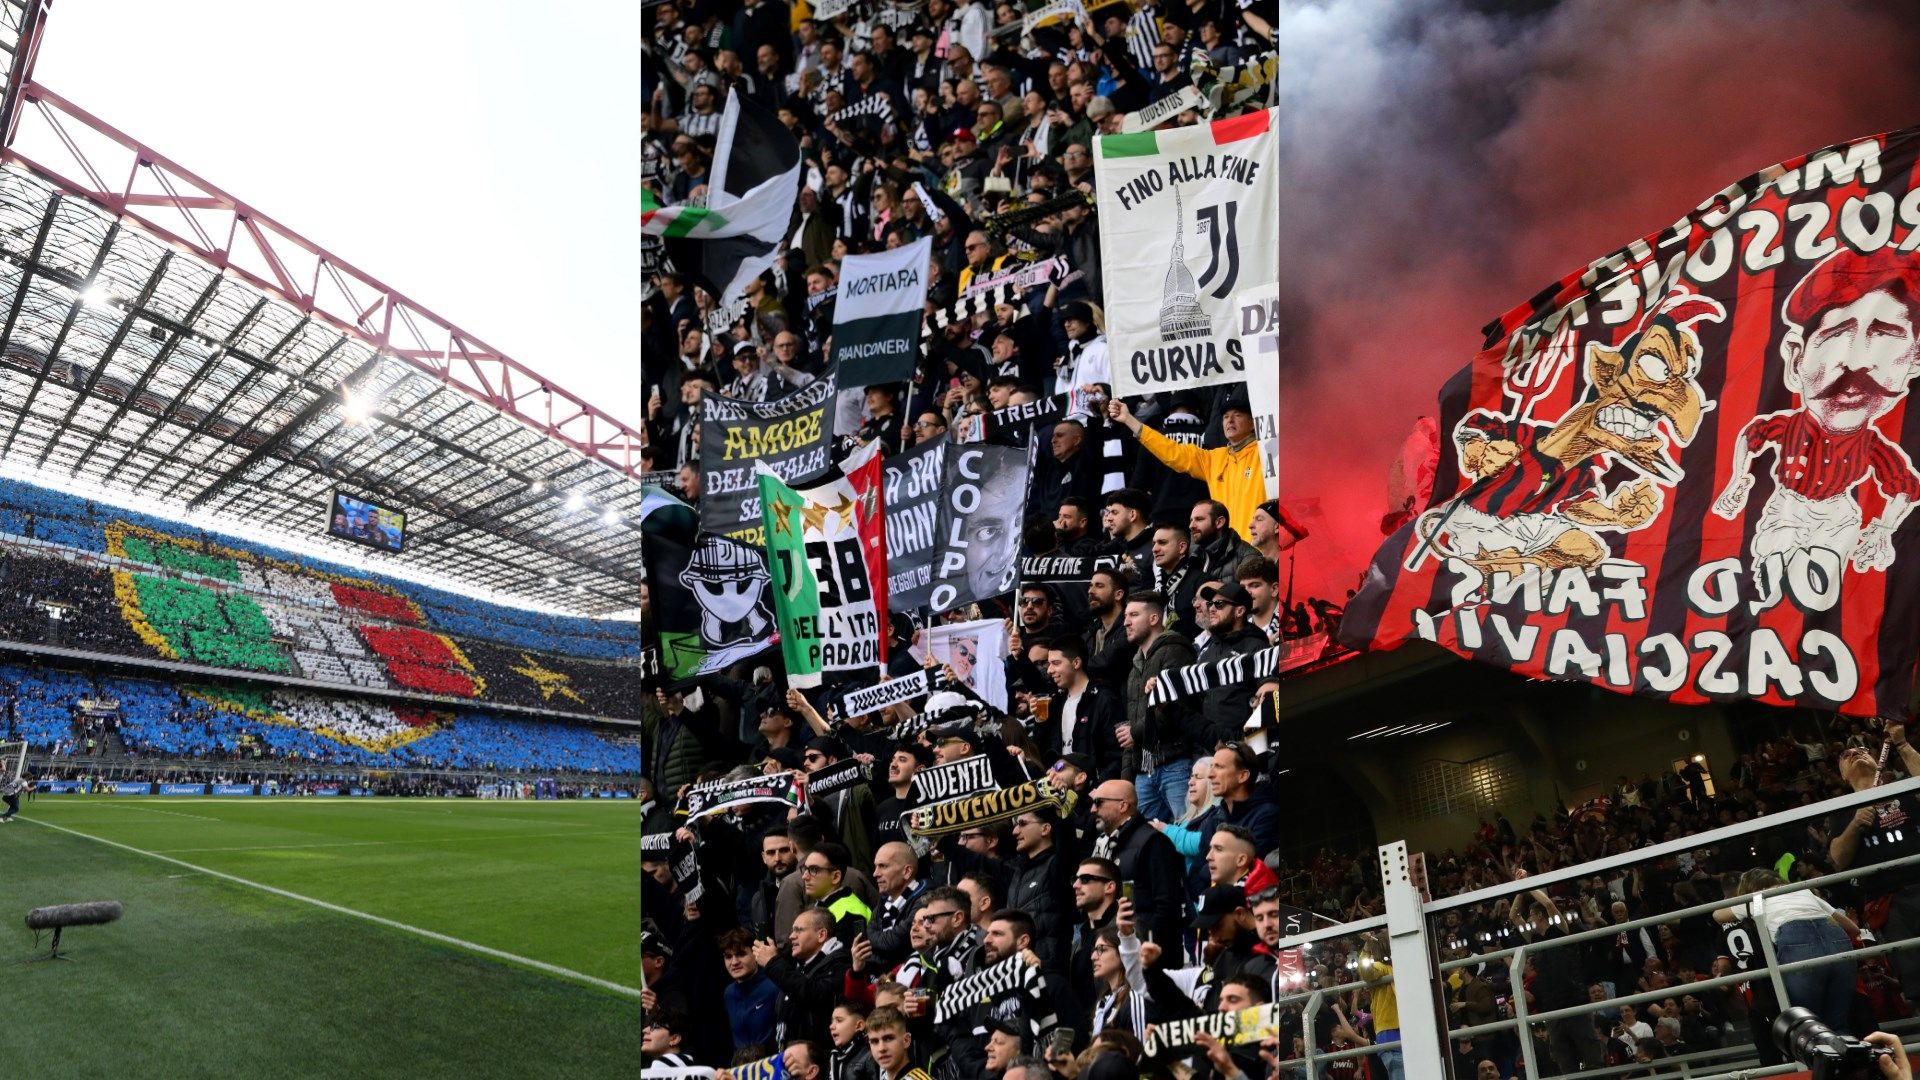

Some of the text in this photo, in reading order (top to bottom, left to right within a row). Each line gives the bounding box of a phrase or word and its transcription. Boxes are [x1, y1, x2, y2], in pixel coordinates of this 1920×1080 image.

[1139, 92, 1184, 125] JUVENTUS
[1115, 154, 1260, 211] FINO ALLA FINE
[846, 268, 919, 299] MORTARA
[1130, 338, 1246, 385] CURVA S
[703, 398, 748, 422] MIO
[993, 396, 1058, 426] TREIA
[722, 408, 824, 461] AMORE
[739, 496, 762, 523] SE
[804, 537, 872, 608] 38
[1050, 556, 1083, 576] FINE
[808, 639, 880, 668] PADRON
[850, 676, 923, 714] JUVENTUS
[935, 782, 1038, 827] JUVENTUS
[1143, 1010, 1236, 1058] UVENTUS
[1332, 1059, 1354, 1069] bwin
